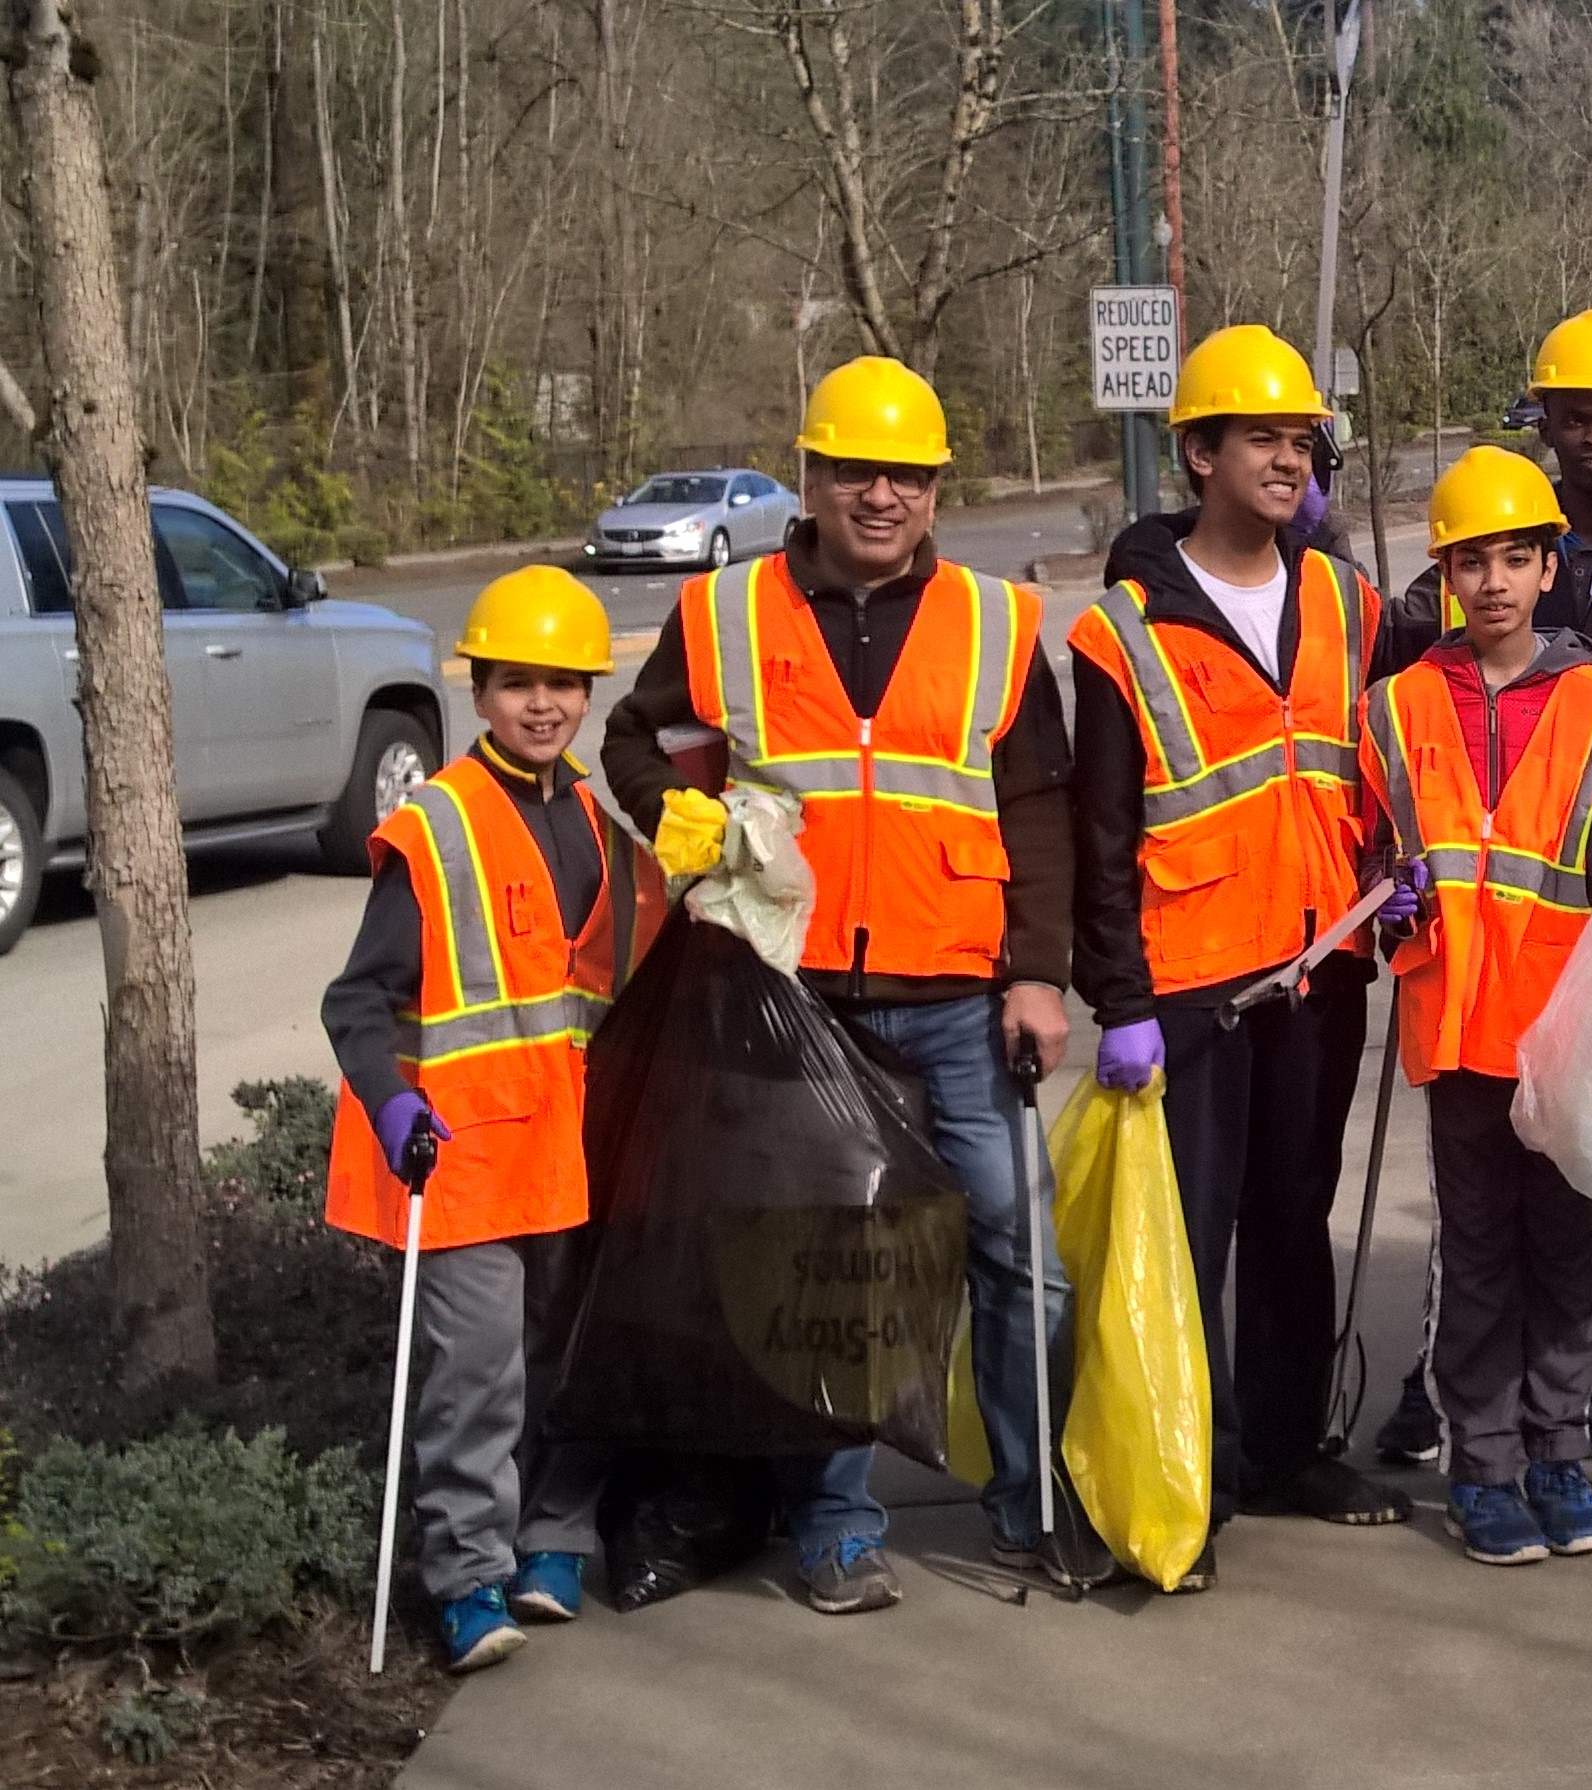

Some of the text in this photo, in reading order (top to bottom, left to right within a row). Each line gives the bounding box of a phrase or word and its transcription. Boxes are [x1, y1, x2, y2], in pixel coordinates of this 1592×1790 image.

[1097, 300, 1172, 326] REDUCED
[1101, 336, 1171, 362] SPEED
[1102, 372, 1172, 398] AHEAD
